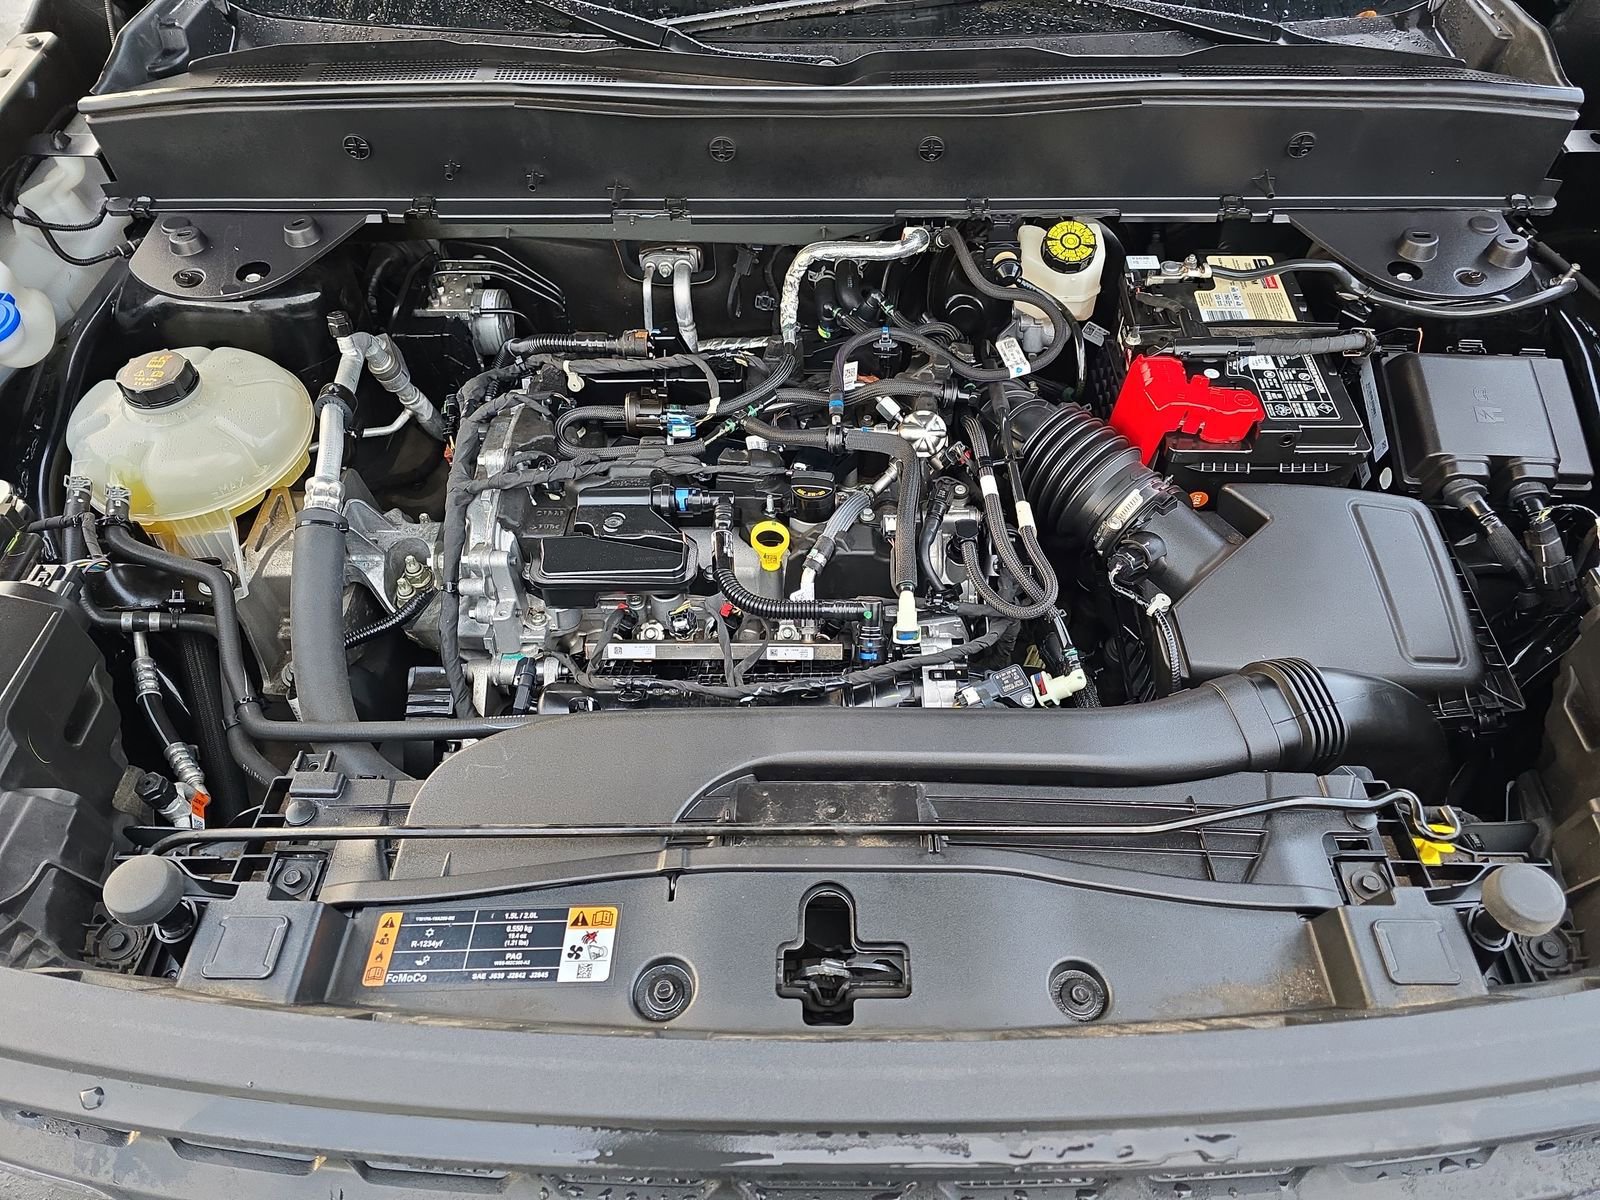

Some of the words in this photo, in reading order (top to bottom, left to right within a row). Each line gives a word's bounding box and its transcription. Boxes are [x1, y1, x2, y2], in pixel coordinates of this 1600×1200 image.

[523, 924, 533, 934] kg
[410, 939, 444, 949] R-1234yf
[505, 952, 523, 961] PAG
[471, 972, 487, 980] SAE
